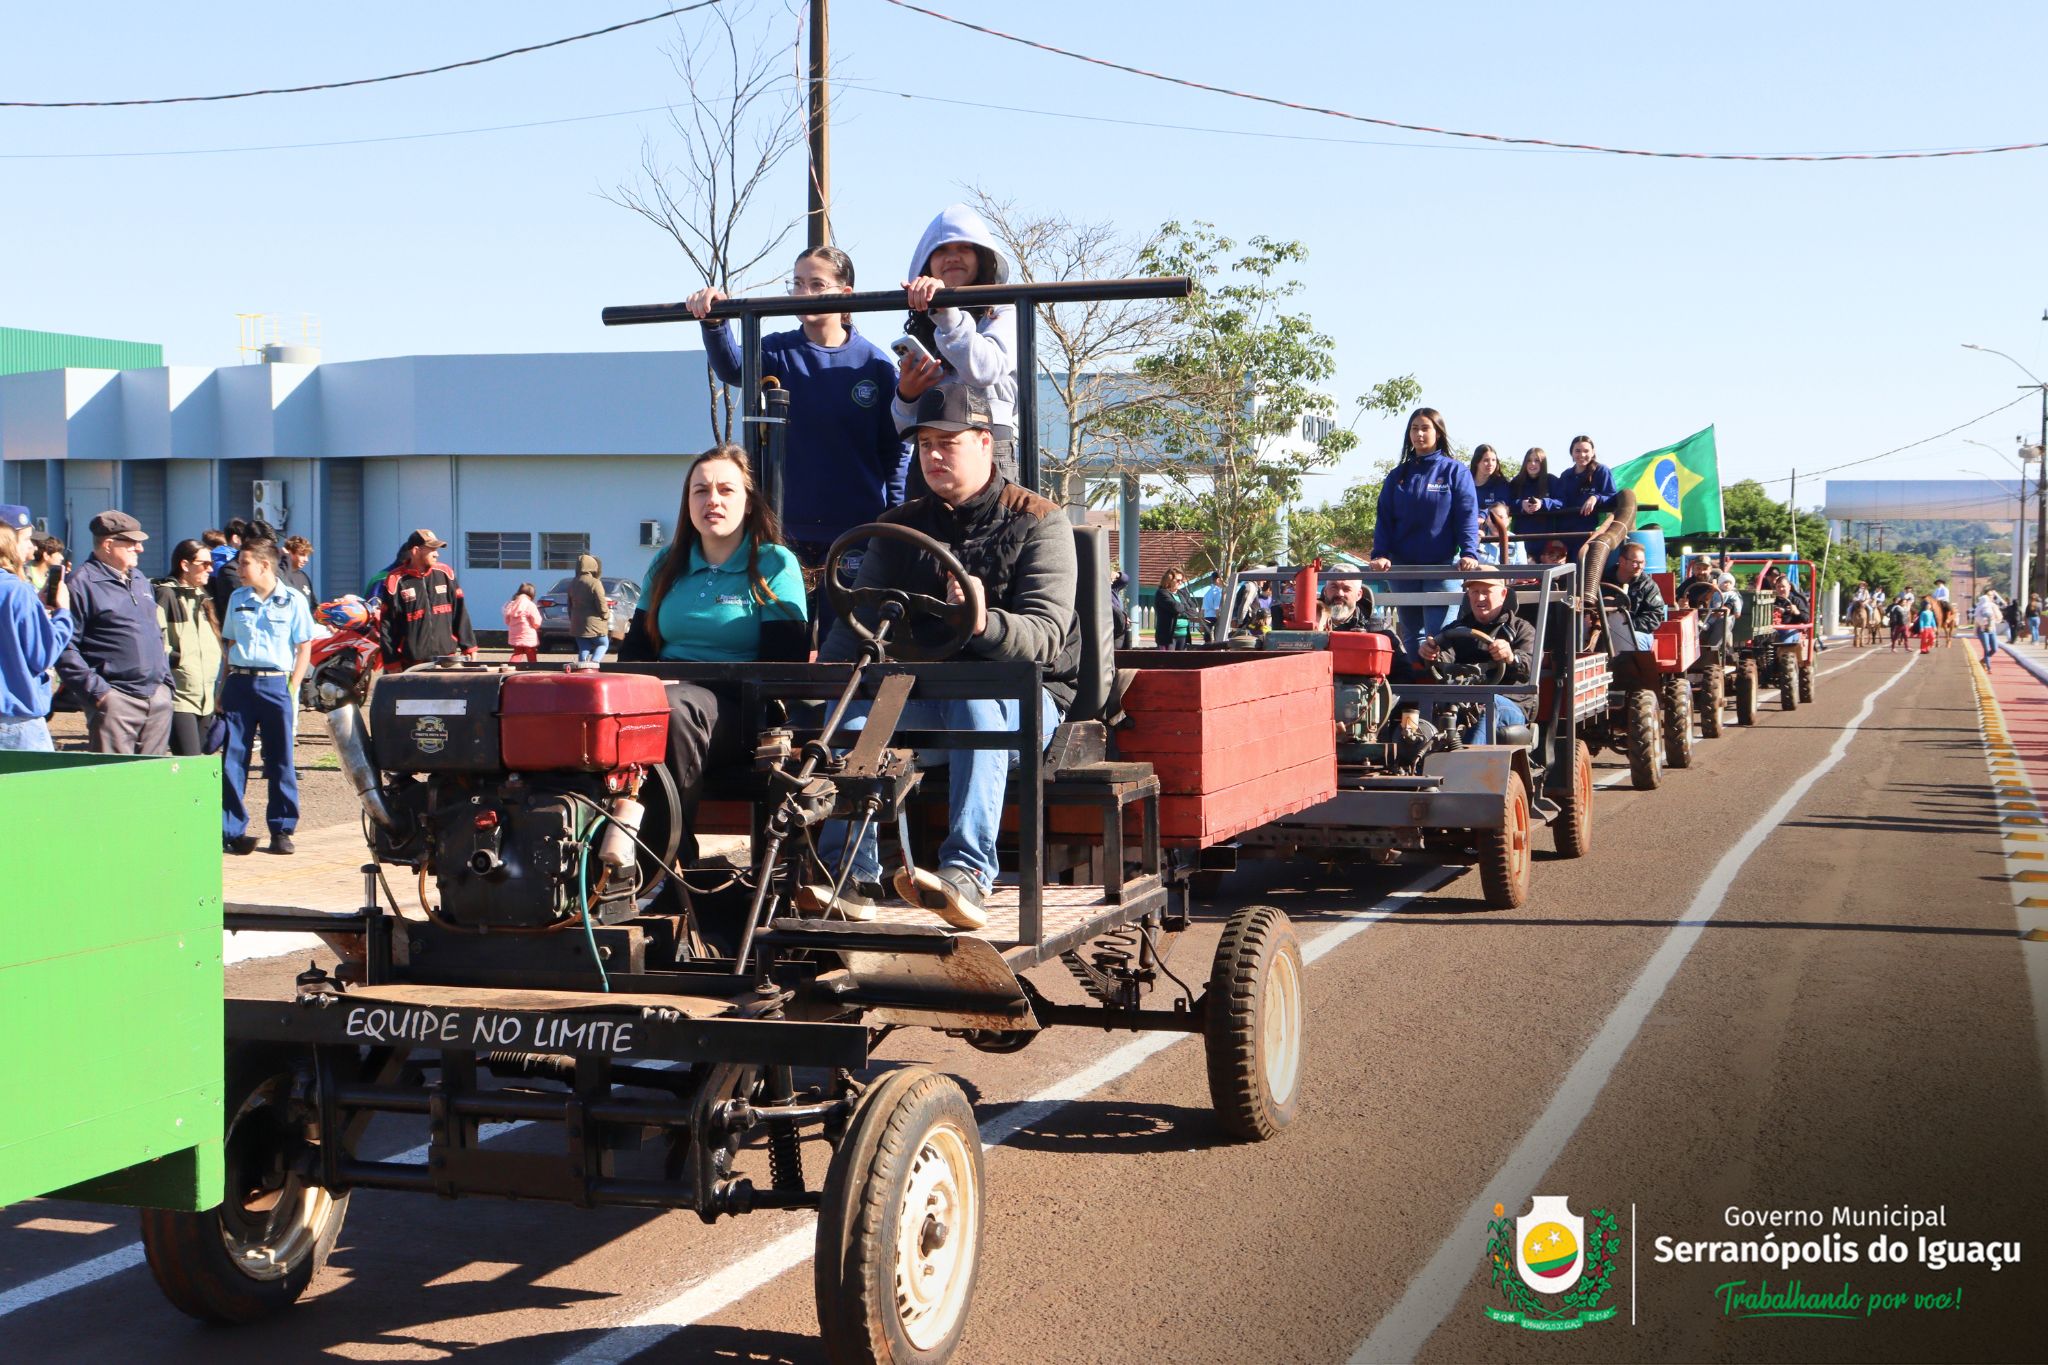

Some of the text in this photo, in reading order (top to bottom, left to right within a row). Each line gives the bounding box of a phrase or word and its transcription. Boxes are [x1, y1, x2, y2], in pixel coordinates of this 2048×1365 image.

[346, 1007, 633, 1053] EQUIPE NO LIMITE
